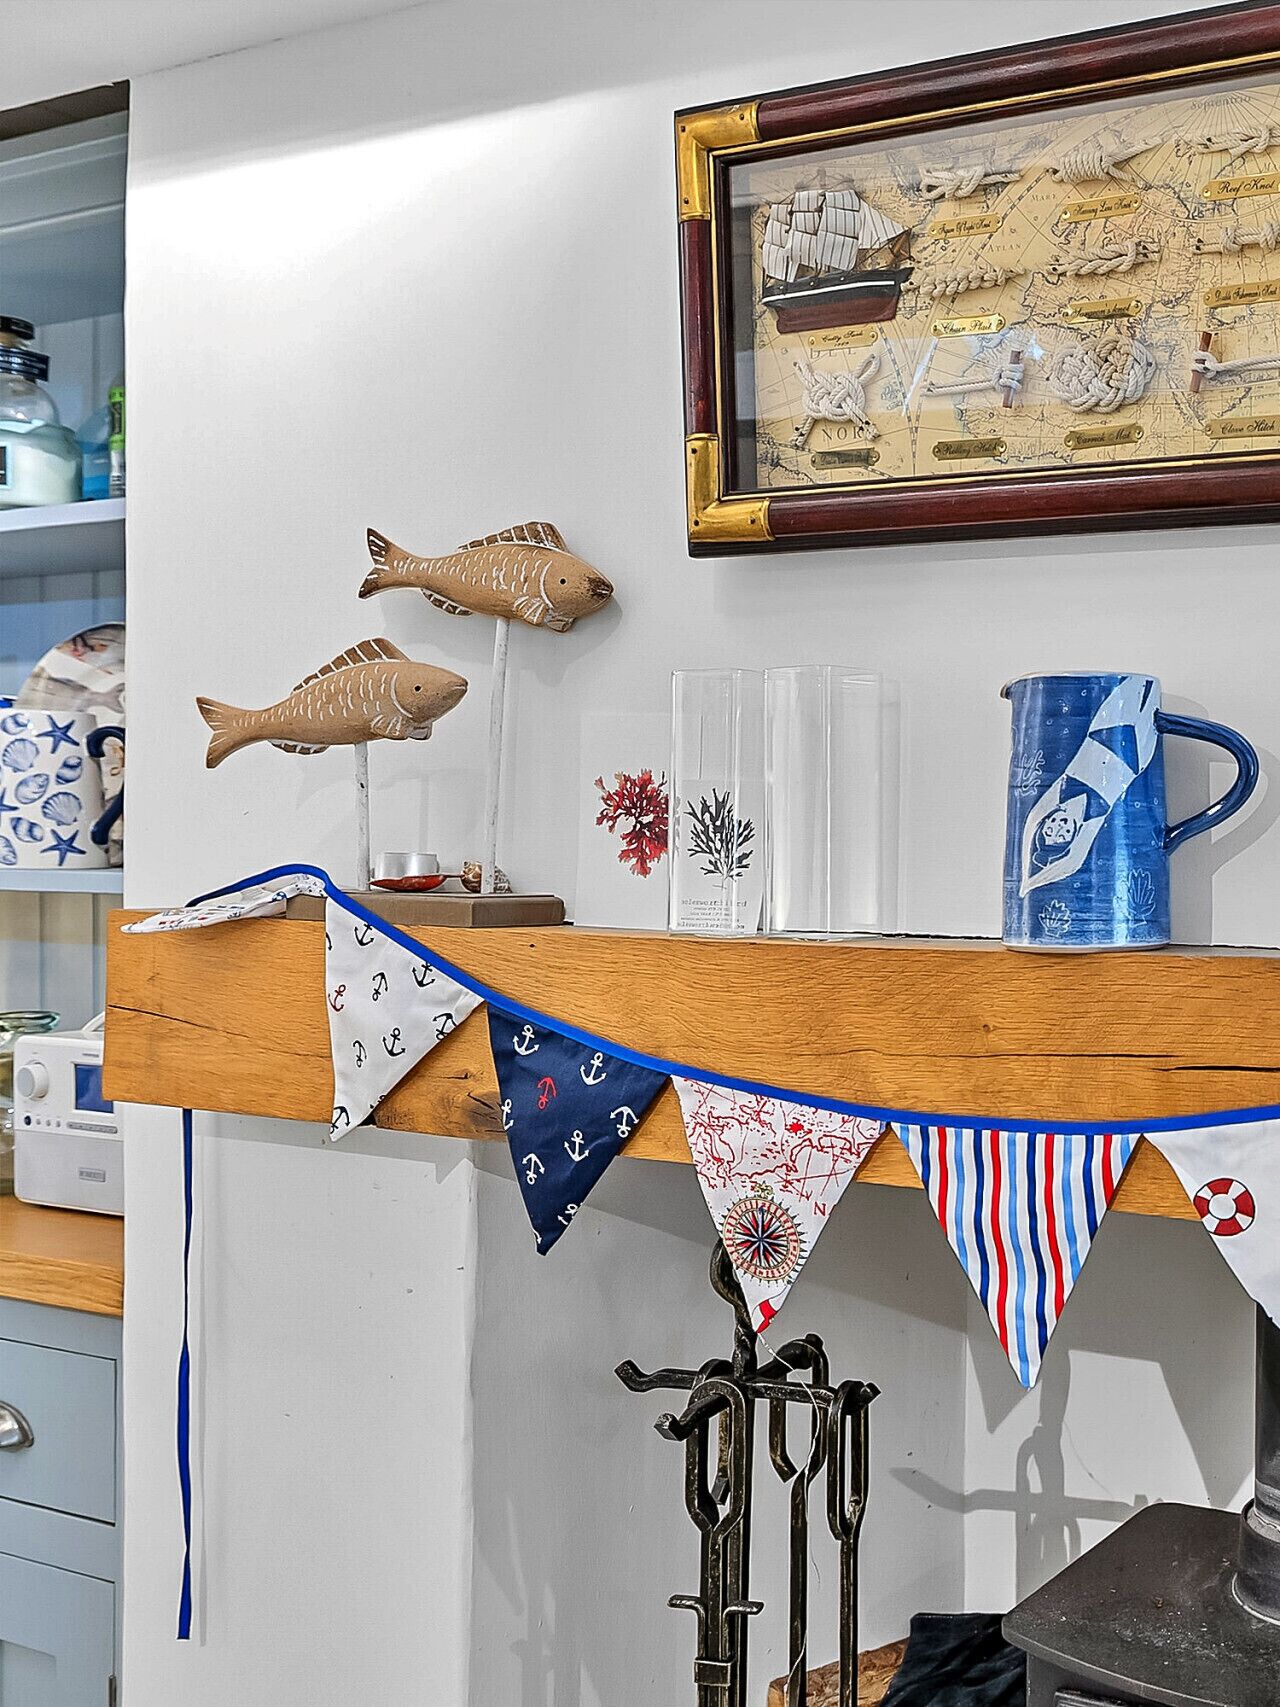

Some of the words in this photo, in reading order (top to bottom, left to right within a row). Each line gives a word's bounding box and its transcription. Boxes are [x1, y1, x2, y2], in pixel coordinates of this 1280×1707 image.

[1217, 181, 1243, 196] Reef
[1244, 178, 1275, 191] Knot
[941, 322, 966, 334] Chain
[969, 320, 992, 331] Plait
[1109, 428, 1130, 440] Mat
[1220, 422, 1244, 435] Clove
[1247, 419, 1275, 432] Hitch
